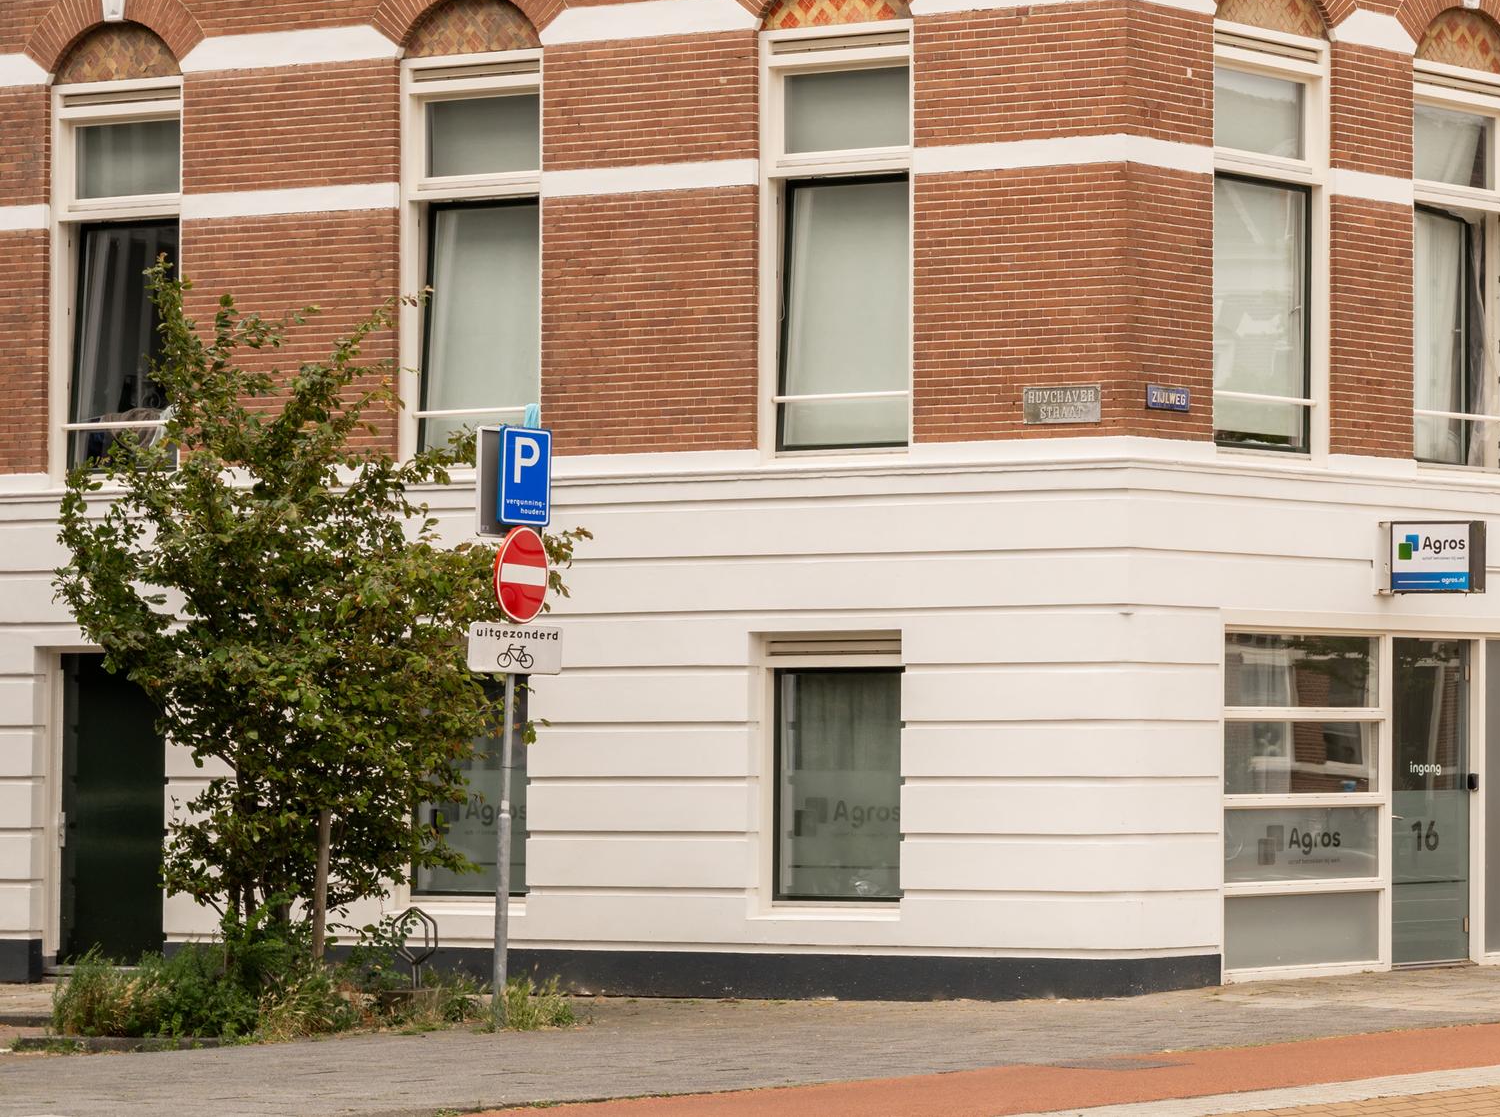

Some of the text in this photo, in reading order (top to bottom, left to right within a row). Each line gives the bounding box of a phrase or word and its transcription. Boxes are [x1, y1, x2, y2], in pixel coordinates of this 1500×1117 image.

[1027, 389, 1095, 404] RUYCHAVER
[1152, 390, 1186, 406] ZIJLWEG
[1040, 405, 1084, 419] STRAAT
[513, 436, 541, 484] P
[520, 507, 546, 516] houders
[1422, 536, 1466, 554] Agros
[1441, 576, 1466, 585] agros.nl
[476, 627, 559, 641] uitgezonderd
[1409, 761, 1442, 776] ingang
[1288, 827, 1341, 855] Agros
[1411, 820, 1439, 852] 16
